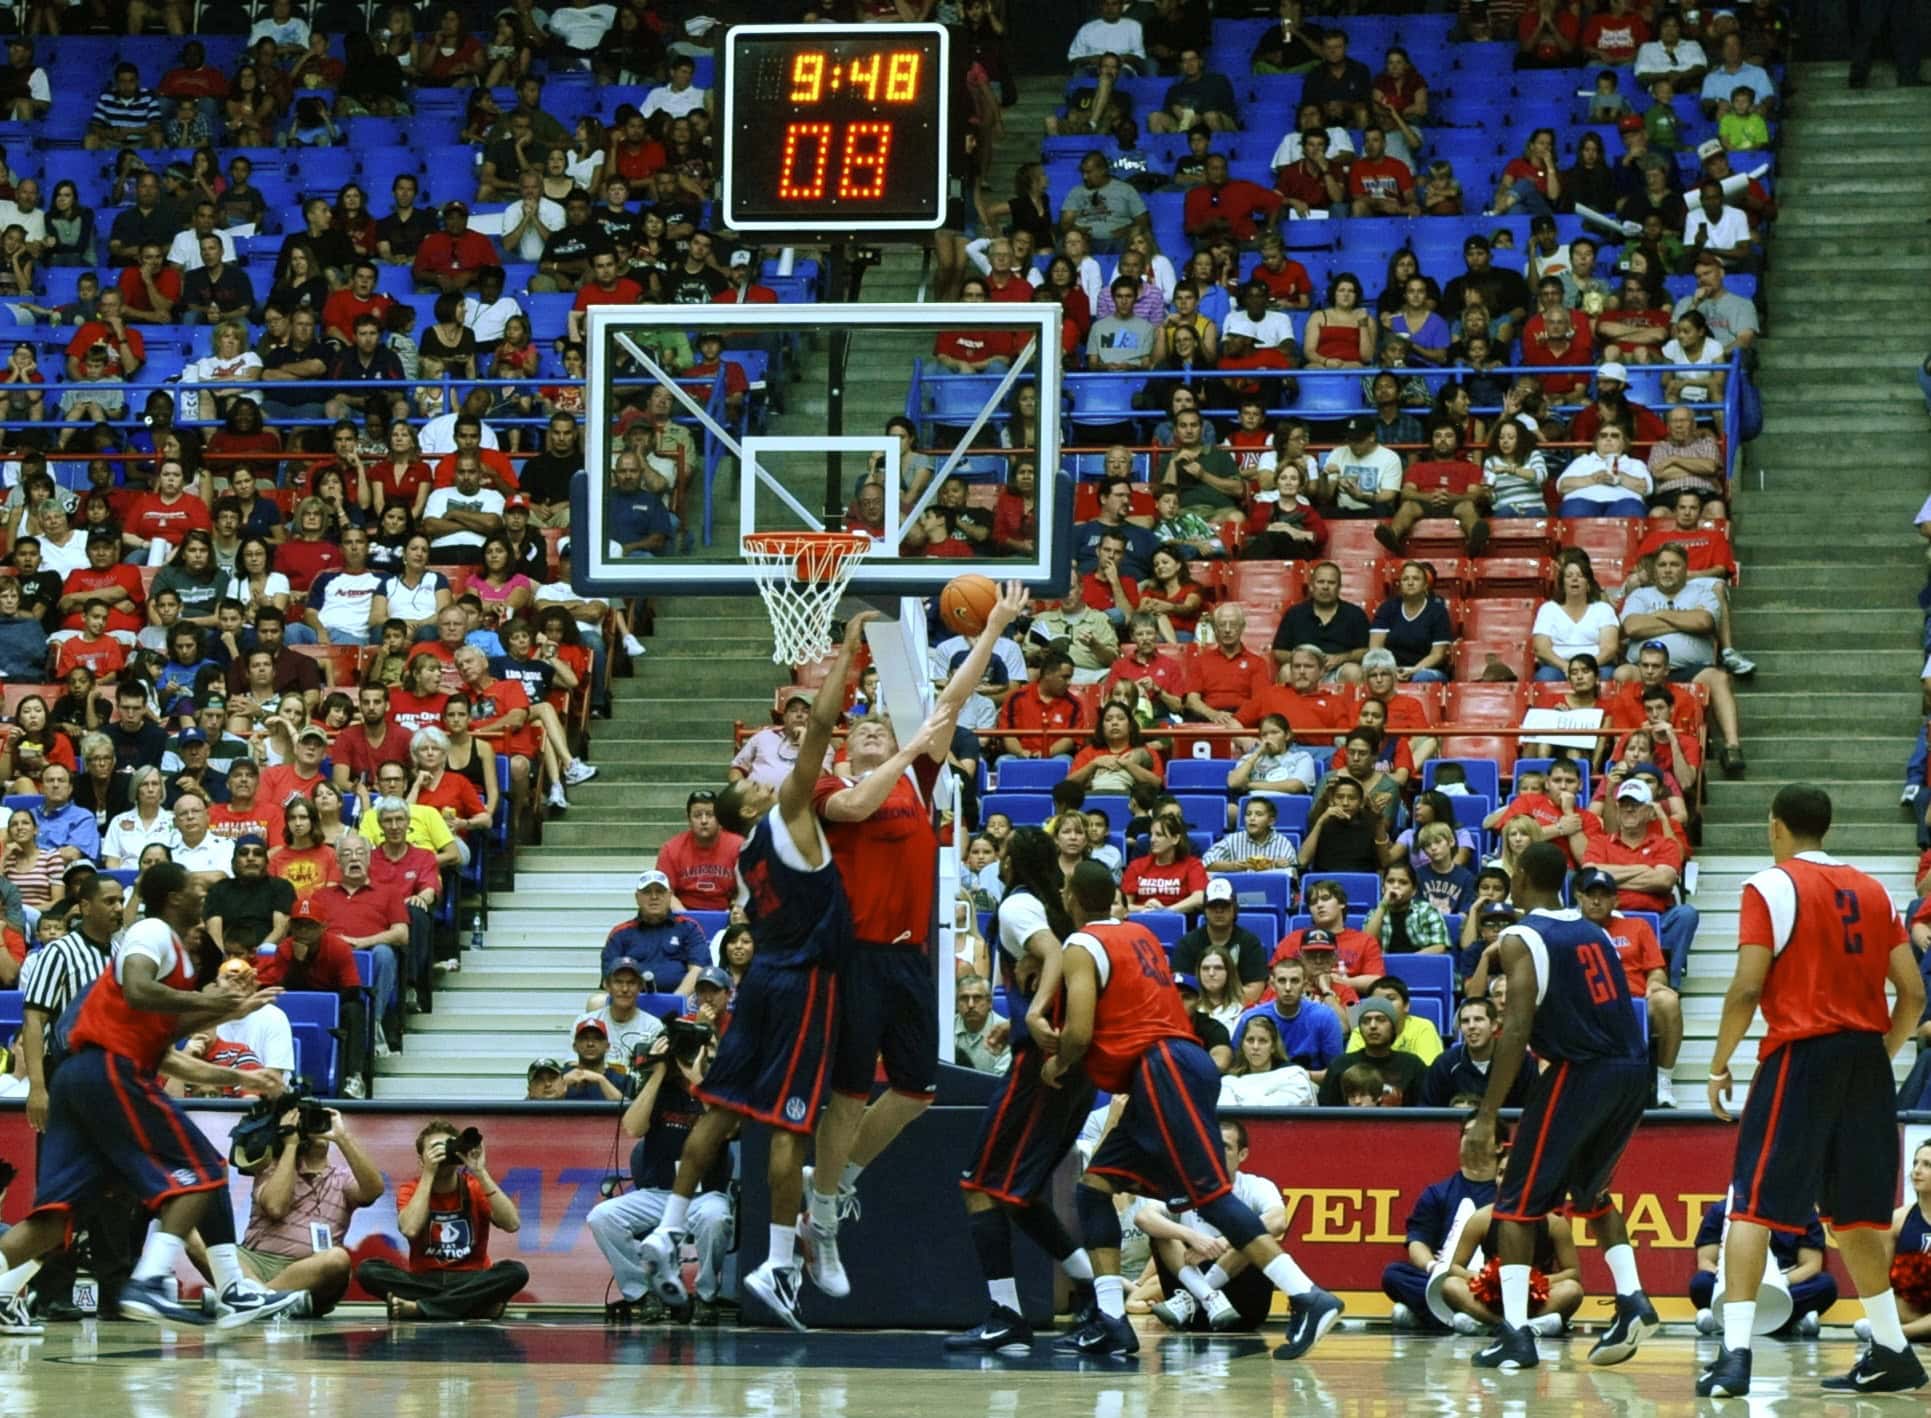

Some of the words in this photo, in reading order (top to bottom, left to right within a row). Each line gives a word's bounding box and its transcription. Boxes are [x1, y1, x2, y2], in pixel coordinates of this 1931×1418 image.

[789, 50, 921, 103] 9:48
[778, 121, 895, 200] 08
[1834, 888, 1865, 956] 2
[1131, 938, 1171, 987] 42
[1575, 942, 1619, 1006] 21
